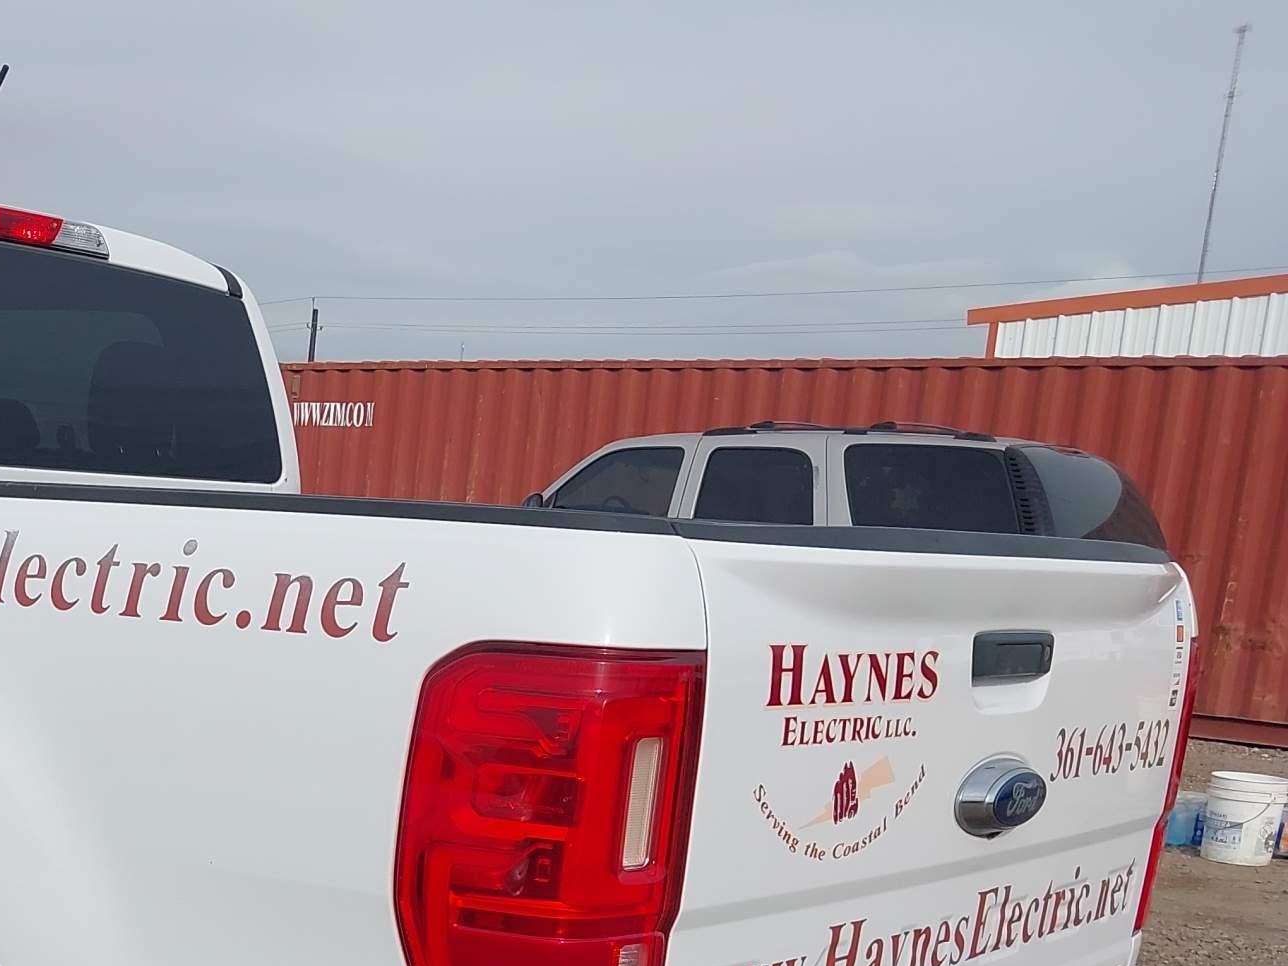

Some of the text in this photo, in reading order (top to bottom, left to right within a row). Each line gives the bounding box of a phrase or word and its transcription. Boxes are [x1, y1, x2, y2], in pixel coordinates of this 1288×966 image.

[766, 643, 939, 708] HAYNES
[782, 716, 881, 747] ELECTRIC
[1050, 717, 1170, 784] 361-643-5432
[753, 763, 926, 861] Serving the Coastal Bend
[1006, 776, 1042, 817] Ford
